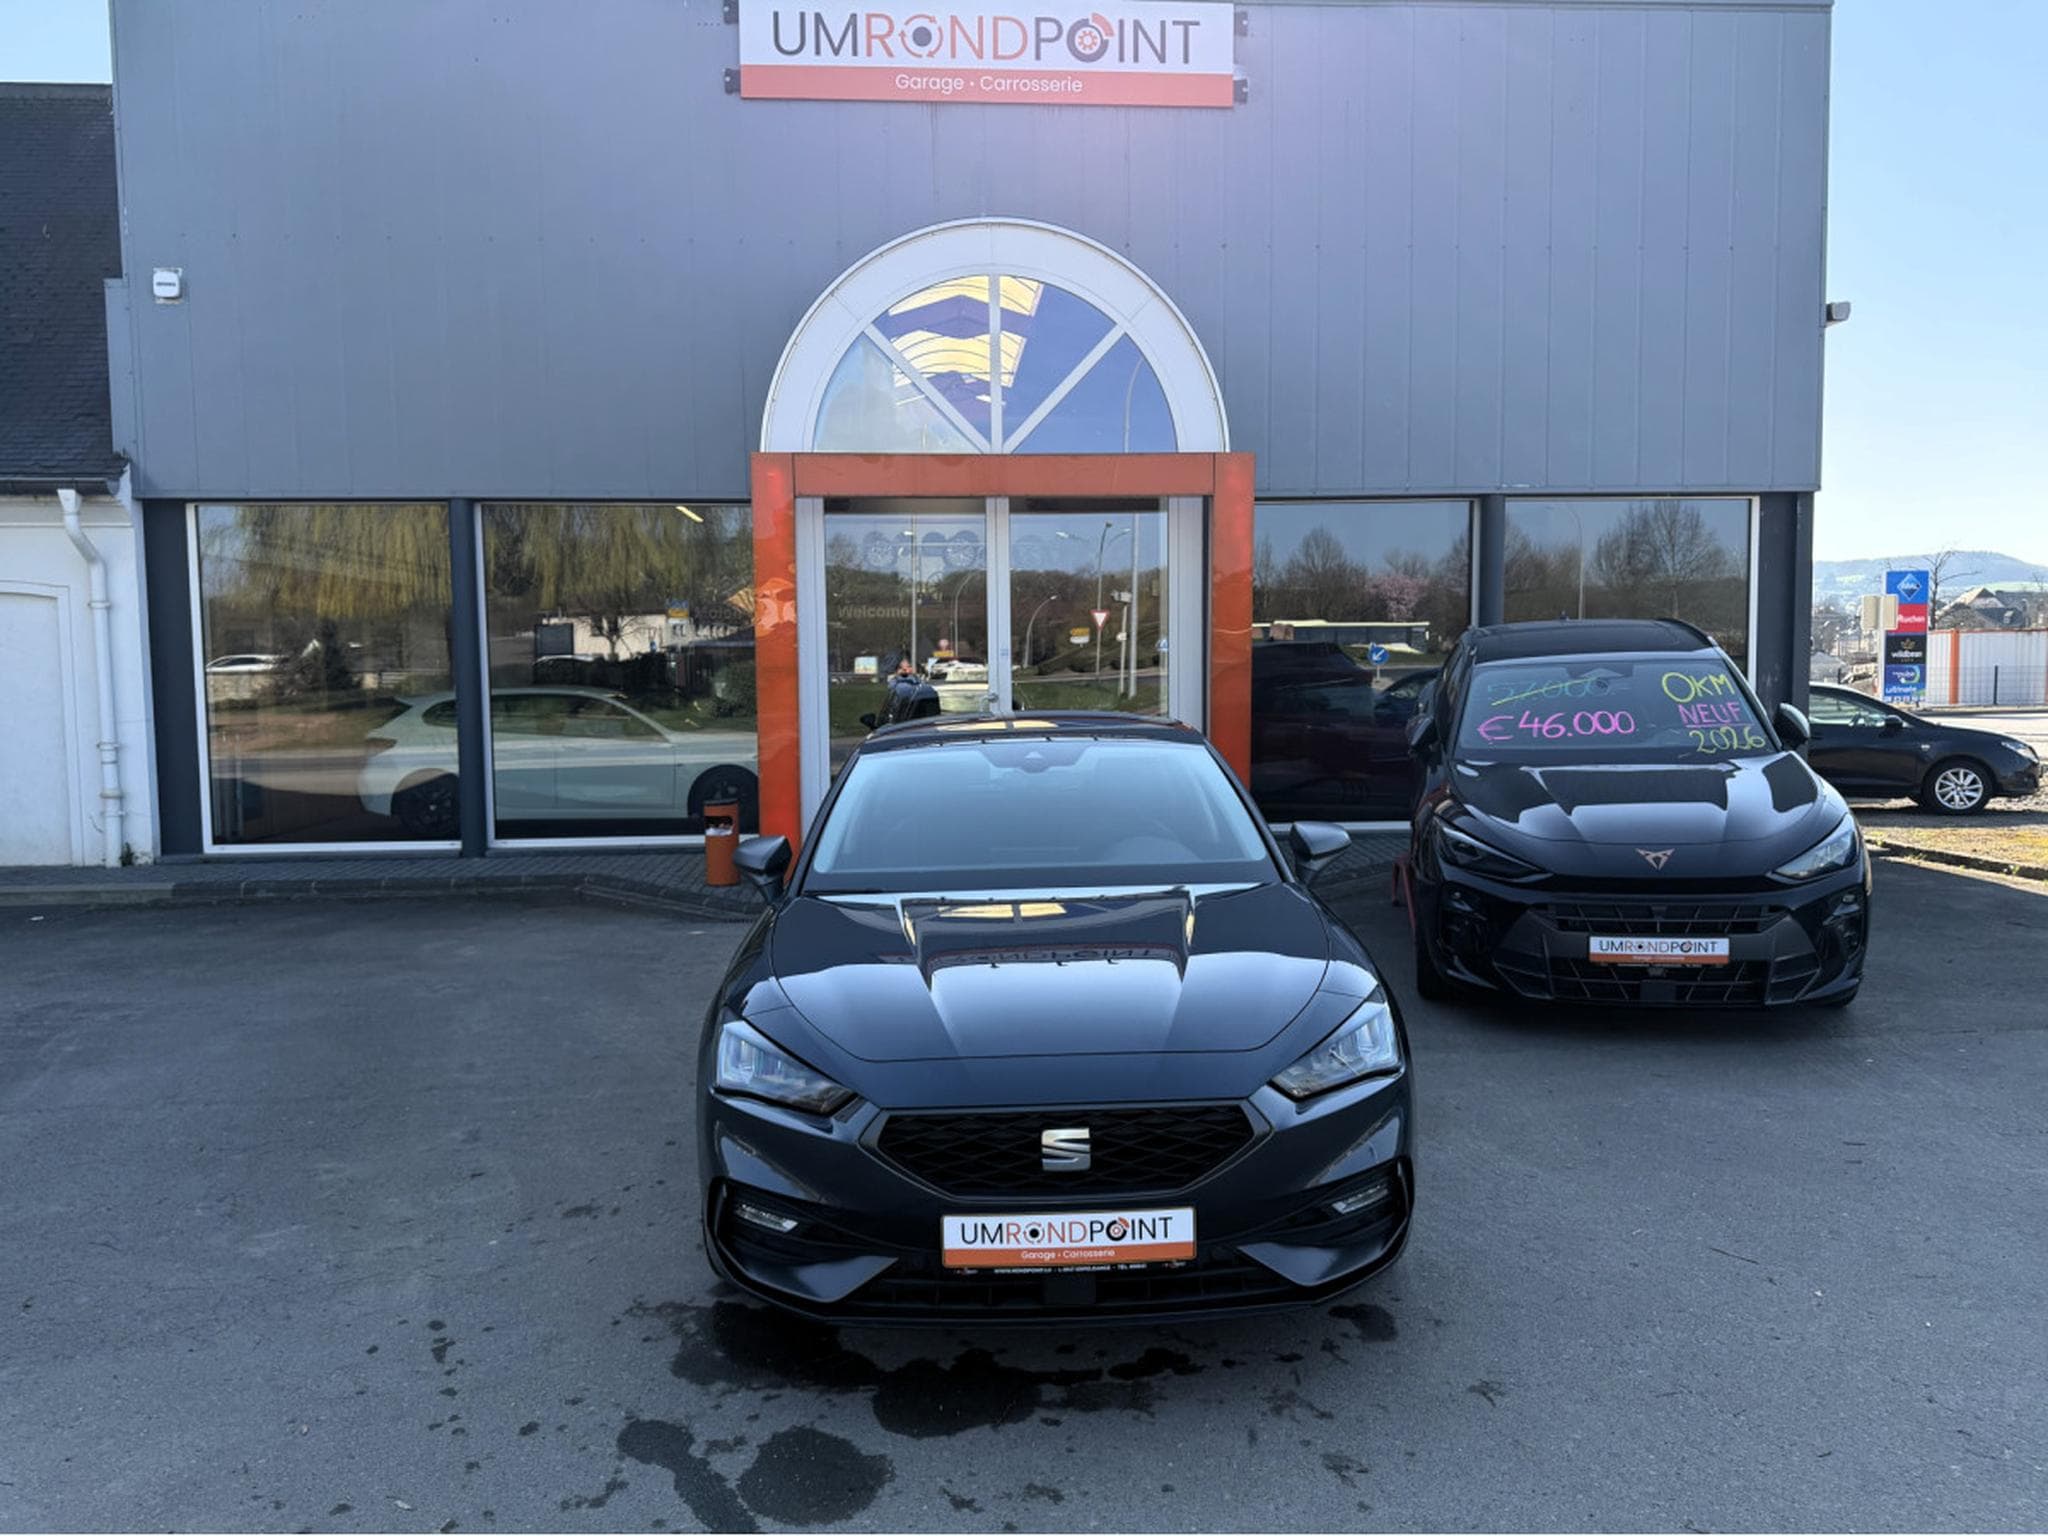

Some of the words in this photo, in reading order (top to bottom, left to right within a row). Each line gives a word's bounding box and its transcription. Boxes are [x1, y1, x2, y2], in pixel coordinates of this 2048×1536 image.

[773, 10, 1201, 64] UMRONDPOINT
[895, 74, 964, 93] Garage
[979, 75, 1083, 93] Carrosserie
[1678, 702, 1740, 724] NEUF
[1689, 726, 1766, 753] 2026
[960, 1216, 1173, 1245] UMRONDPOINT
[1021, 1250, 1056, 1260] Garage
[1063, 1248, 1115, 1258] Carrosserie
